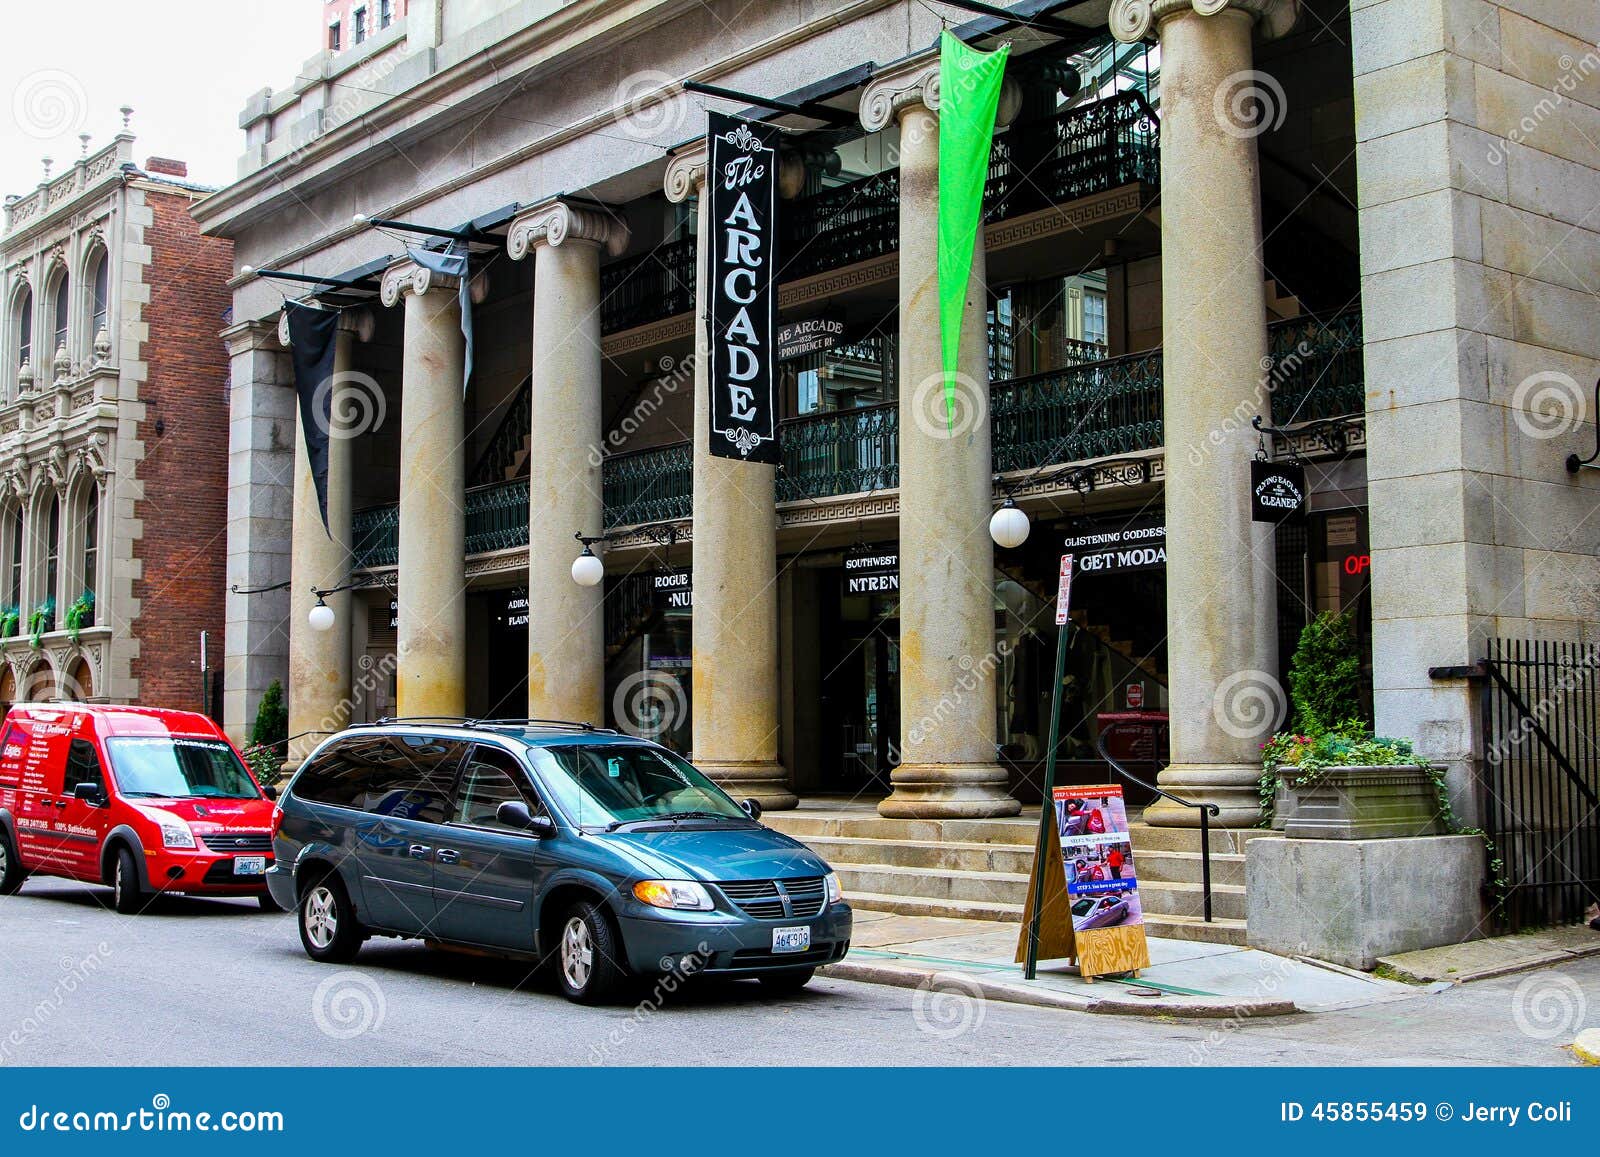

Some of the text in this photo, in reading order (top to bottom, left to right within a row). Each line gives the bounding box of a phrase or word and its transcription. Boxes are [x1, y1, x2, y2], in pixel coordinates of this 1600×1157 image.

[724, 155, 765, 190] The
[724, 191, 763, 422] ARCADE
[778, 320, 843, 346] HE ARCADE
[781, 340, 823, 358] PROVIDENCE
[1255, 475, 1278, 496] FLYING
[1260, 495, 1298, 509] CLEANER
[1064, 532, 1120, 547] GLISTENING
[846, 555, 897, 569] SOUTHWEST
[1080, 547, 1168, 571] GET MODA
[655, 574, 688, 587] ROGUE
